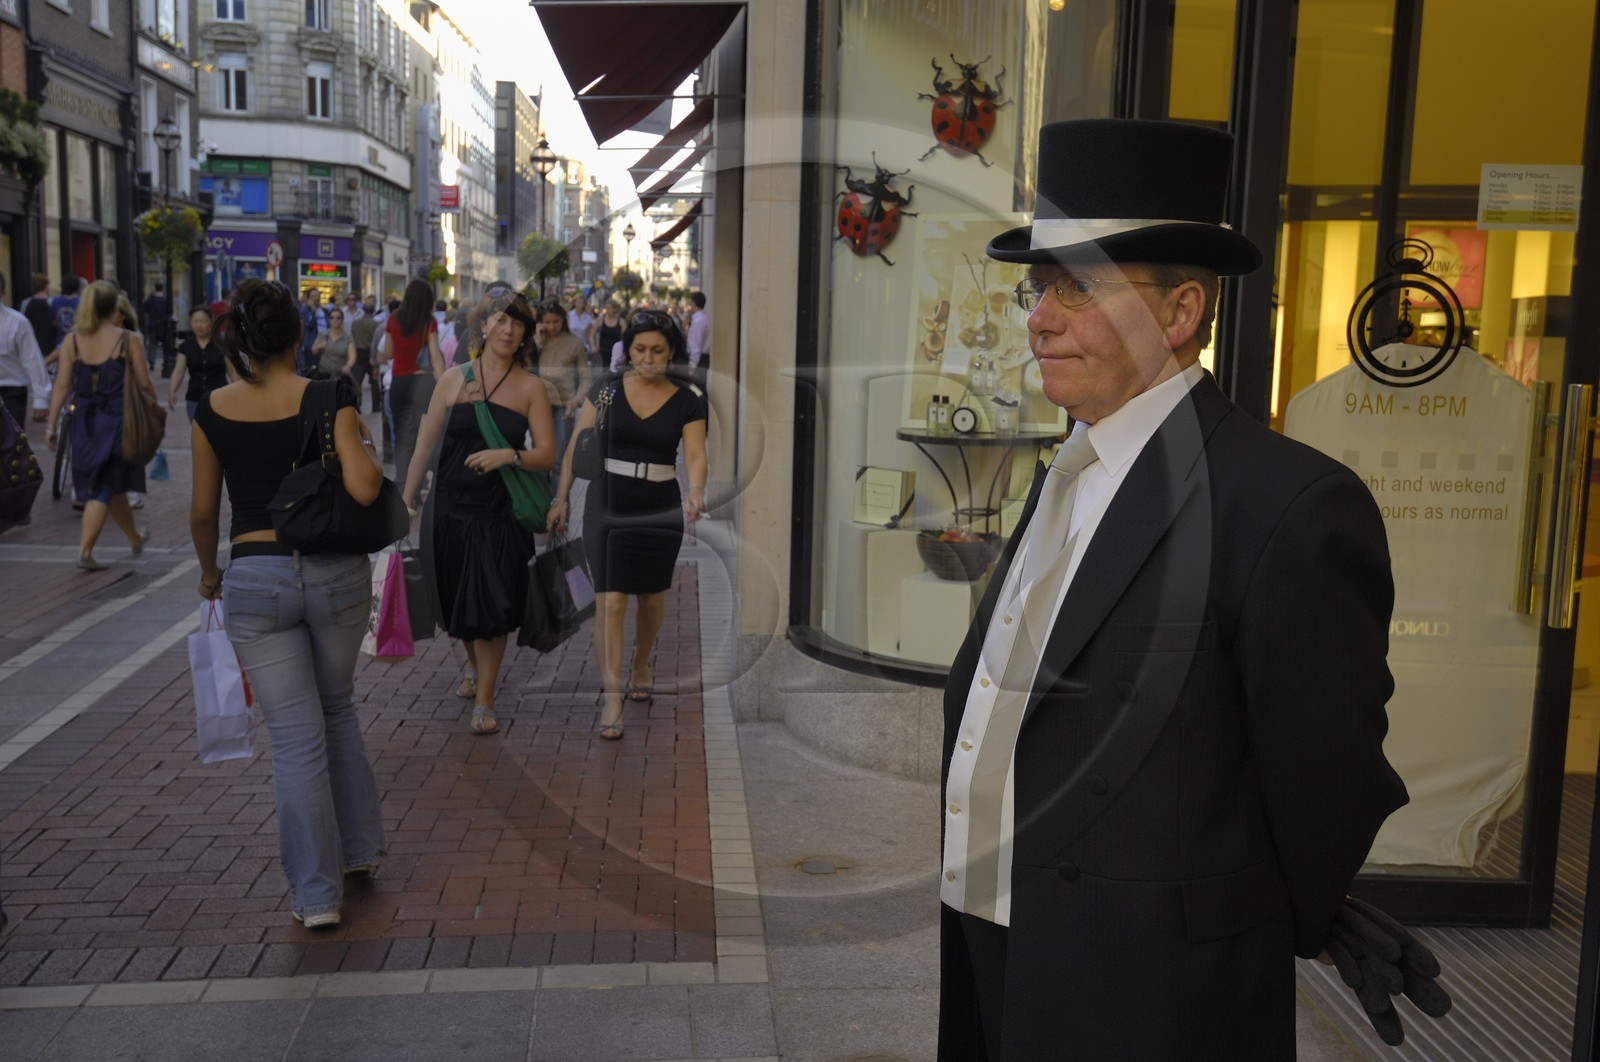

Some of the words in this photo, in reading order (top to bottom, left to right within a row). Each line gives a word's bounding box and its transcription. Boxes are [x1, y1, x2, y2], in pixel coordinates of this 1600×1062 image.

[1489, 170, 1523, 180] Opening
[1345, 392, 1394, 415] 9AM
[1417, 395, 1467, 417] 8PM
[1391, 475, 1423, 493] and
[1430, 476, 1506, 494] weekend
[1381, 505, 1418, 519] ours
[1424, 506, 1444, 520] as
[1450, 503, 1509, 520] normal
